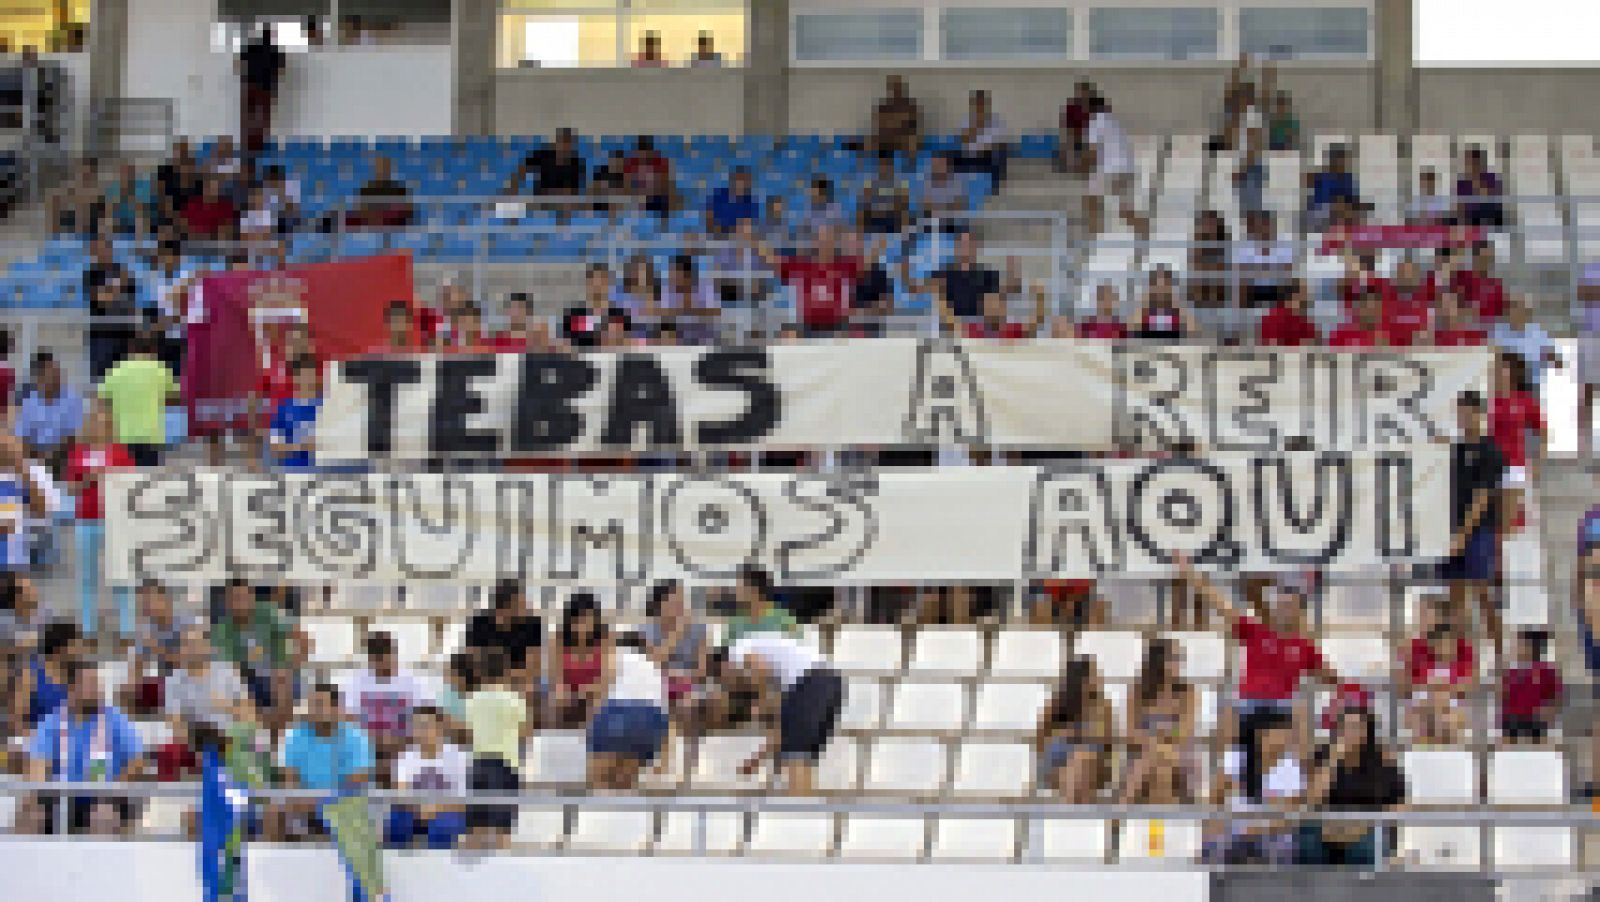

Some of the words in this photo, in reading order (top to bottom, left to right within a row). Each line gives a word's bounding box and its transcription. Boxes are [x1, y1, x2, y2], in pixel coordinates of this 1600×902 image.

[340, 345, 783, 452] TEBAS
[910, 340, 985, 447] A
[1112, 346, 1450, 450] REIR
[127, 471, 879, 581] SEGUIMOS
[1025, 456, 1414, 572] AQUI
